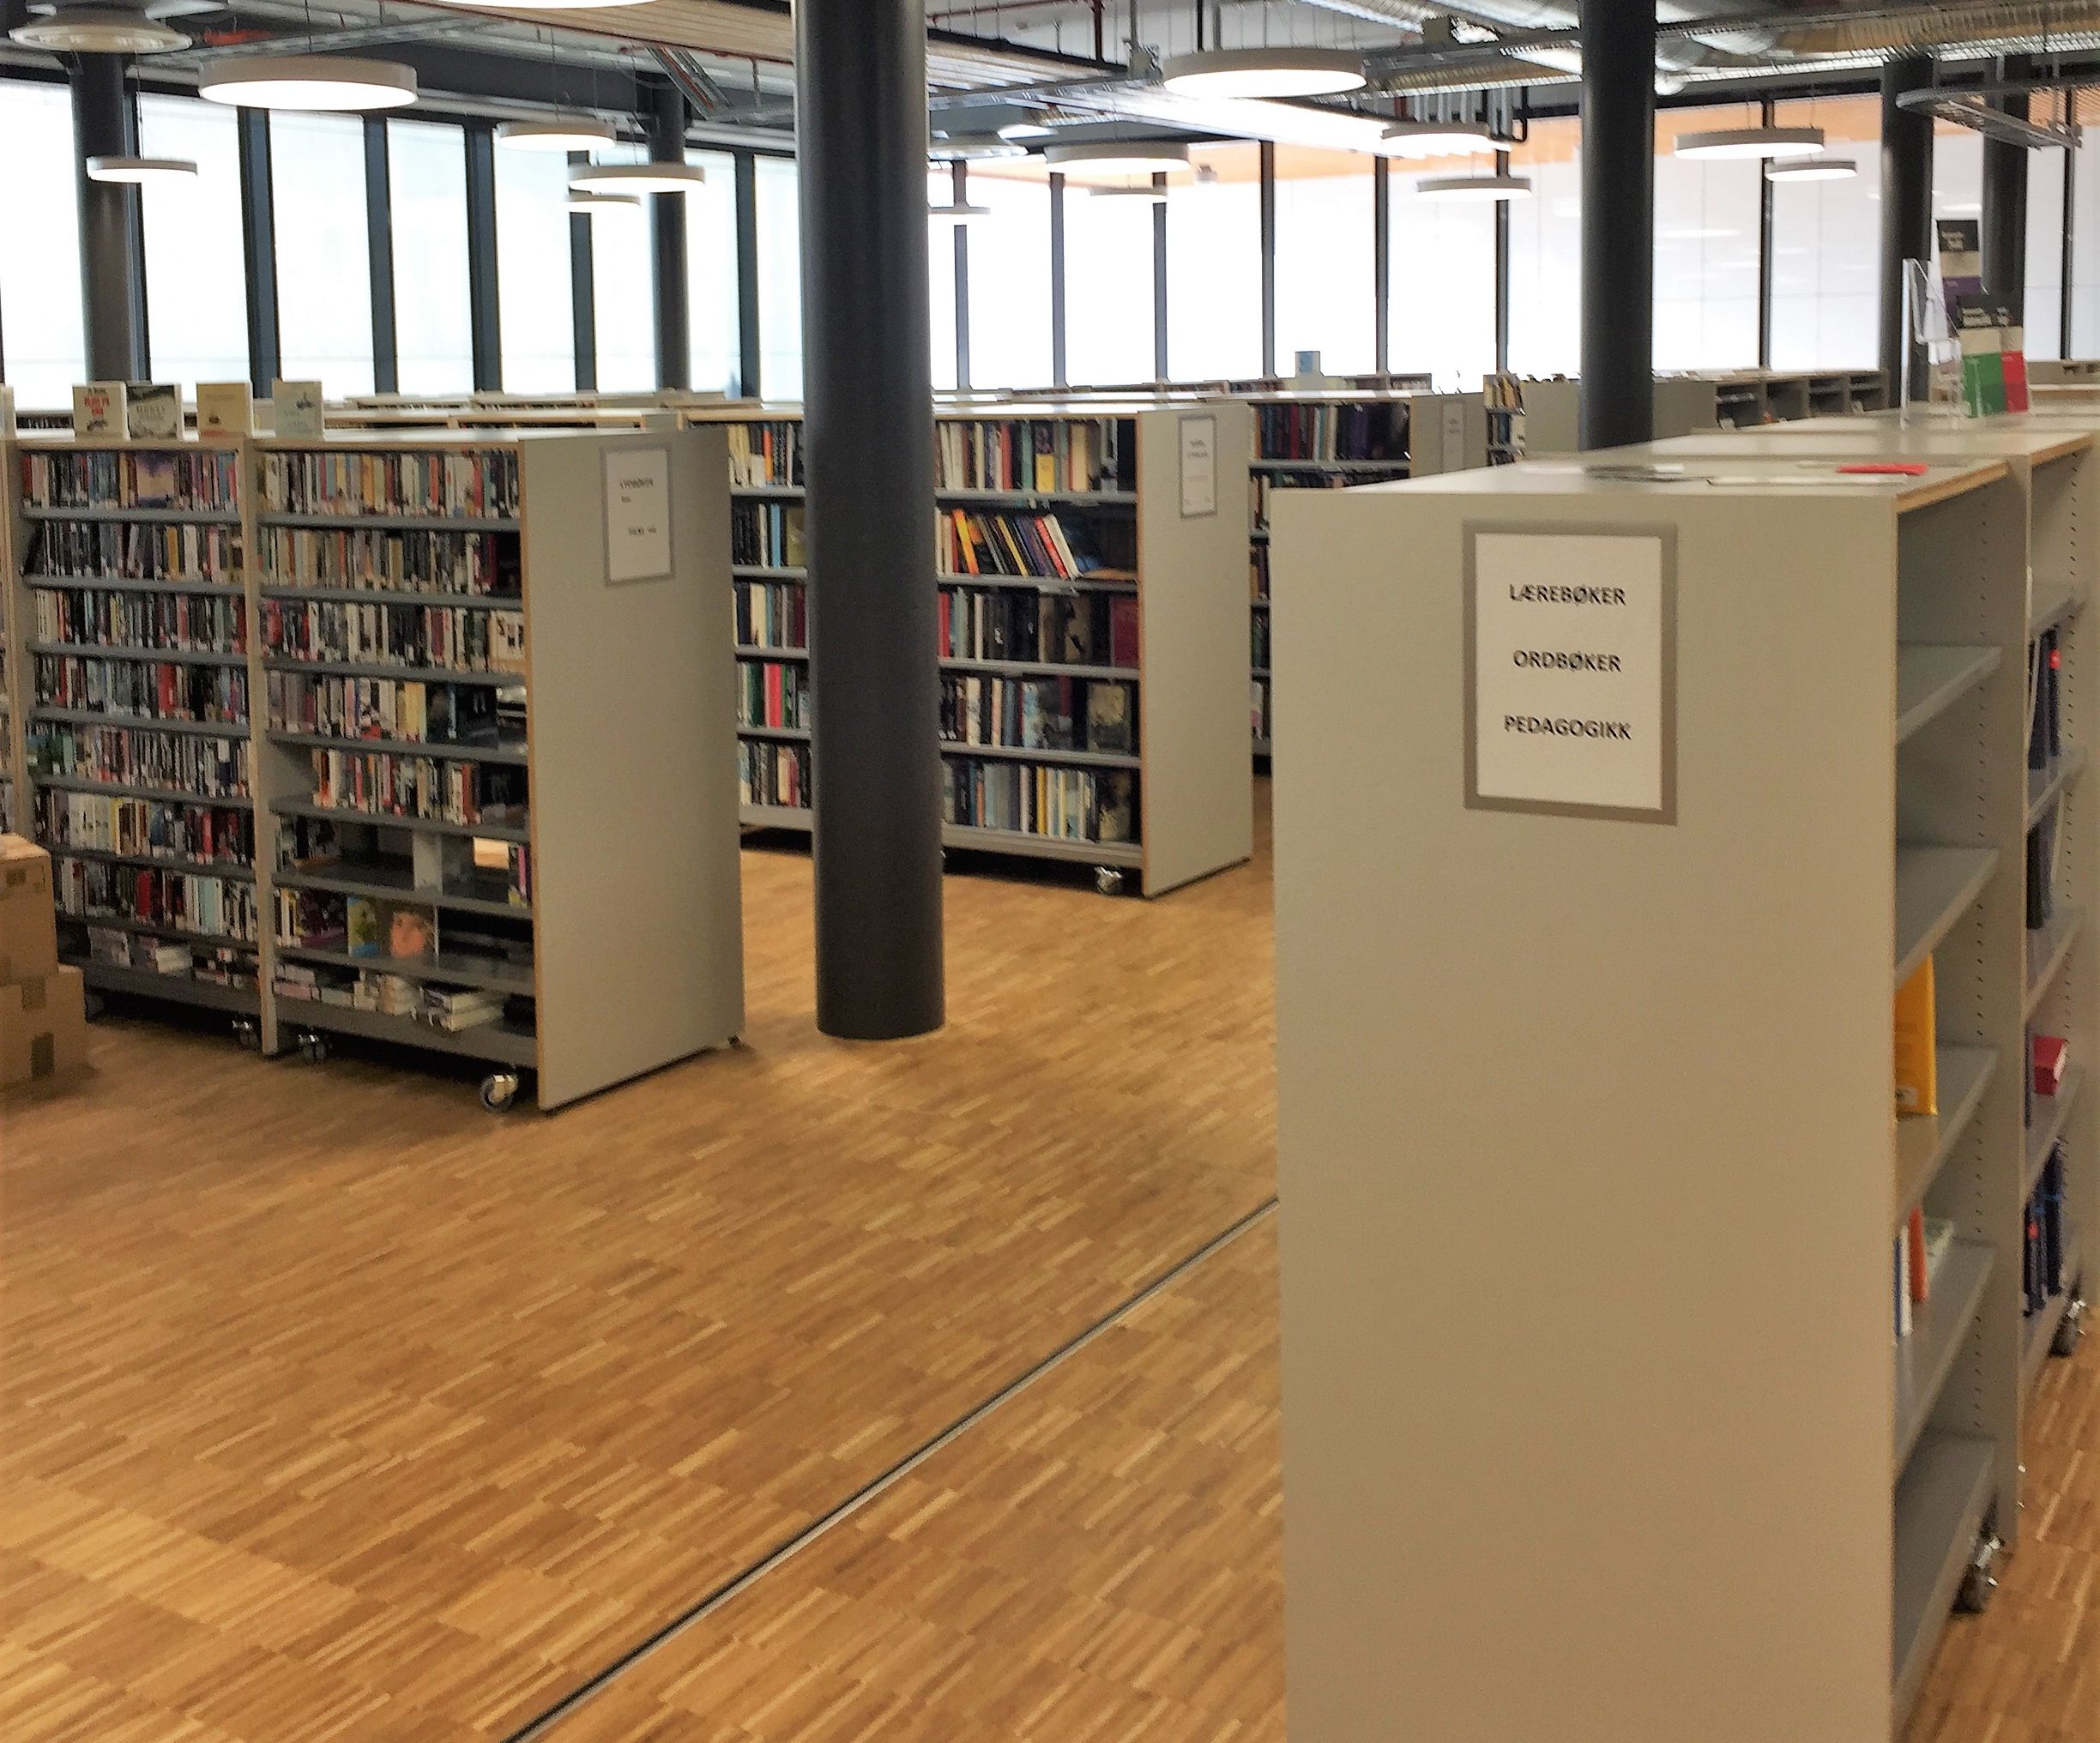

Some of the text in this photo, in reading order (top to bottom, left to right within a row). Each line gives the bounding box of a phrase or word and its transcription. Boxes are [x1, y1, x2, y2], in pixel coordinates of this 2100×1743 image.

[1509, 583, 1626, 606] LÆREBØKER
[1513, 649, 1621, 672] ORDBØKER
[1504, 715, 1632, 739] PEDAGOGIKK
